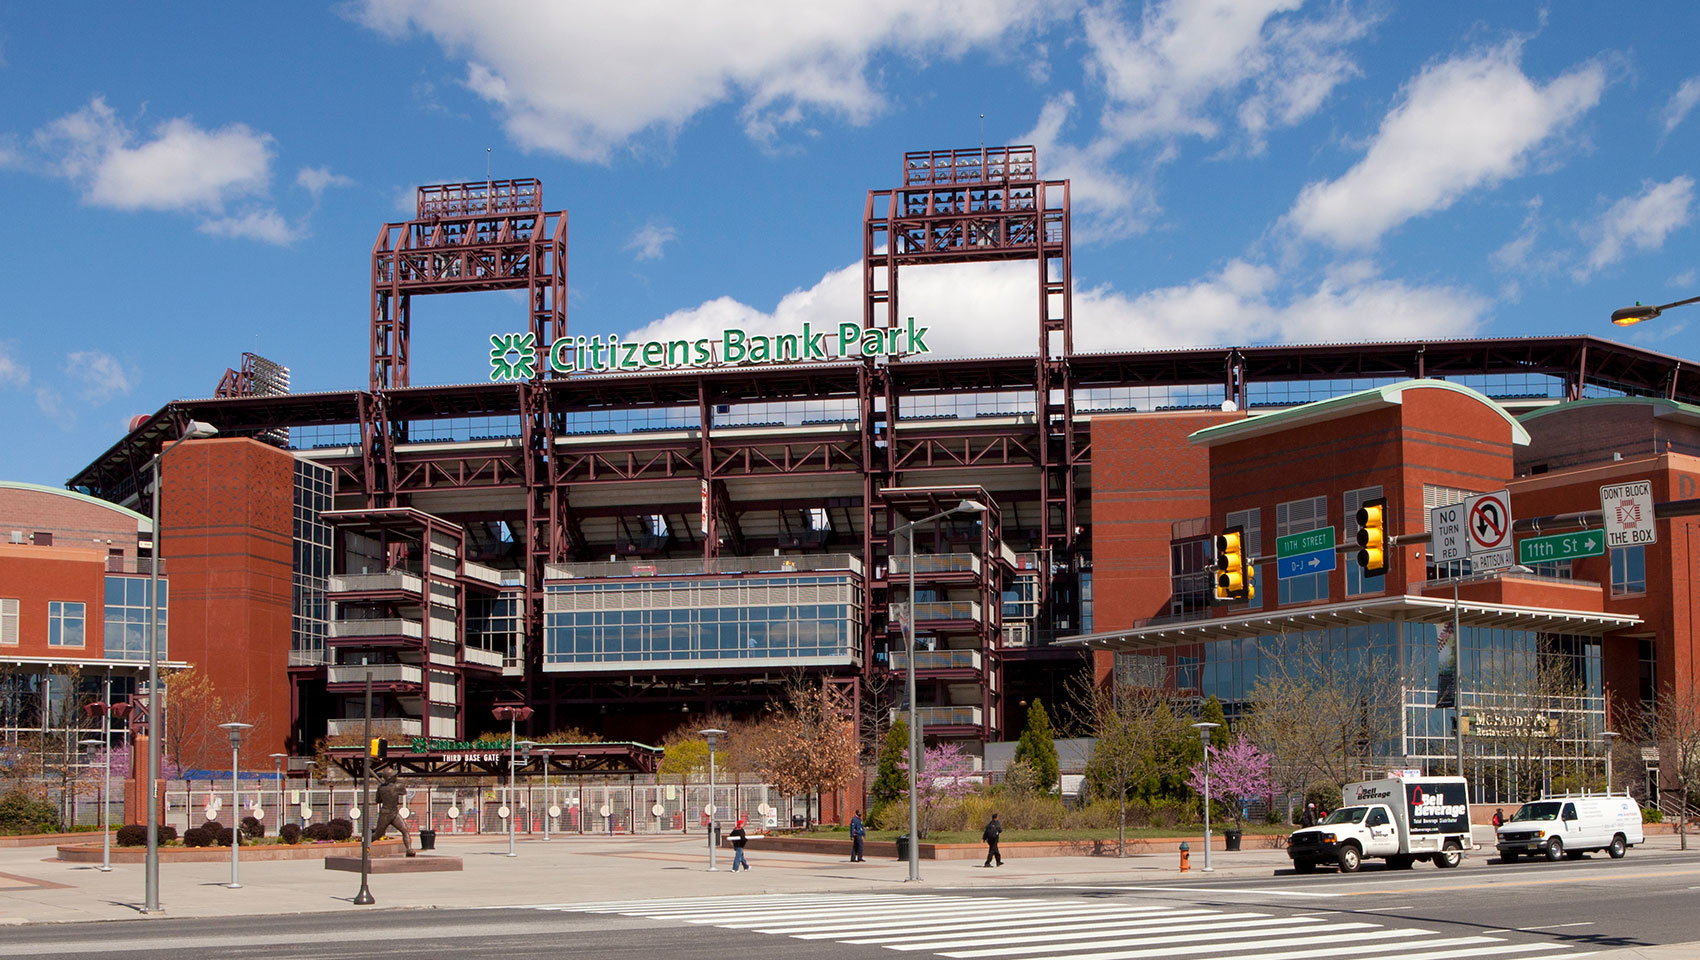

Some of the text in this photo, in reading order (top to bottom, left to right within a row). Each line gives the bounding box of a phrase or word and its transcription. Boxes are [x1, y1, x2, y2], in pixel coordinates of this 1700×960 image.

[550, 316, 931, 373] Citizens Bank Park
[1625, 485, 1649, 497] BLOCK
[1439, 510, 1456, 524] NO
[1438, 524, 1459, 536] TURN
[1284, 534, 1327, 551] 11TH STREET
[1444, 538, 1455, 547] ON
[1609, 529, 1653, 545] THE BOX
[1442, 549, 1458, 559] RED
[1527, 538, 1578, 558] 11th St
[1291, 560, 1304, 571] D-J
[1480, 553, 1504, 569] PATTISON
[430, 739, 474, 750] Citizens
[476, 738, 504, 750] Bank
[443, 753, 499, 762] THIRD BASE GATE
[1357, 791, 1391, 800] Beverage
[1361, 787, 1377, 795] Bell
[1422, 793, 1444, 806] Bell
[1414, 804, 1466, 817] Beverage
